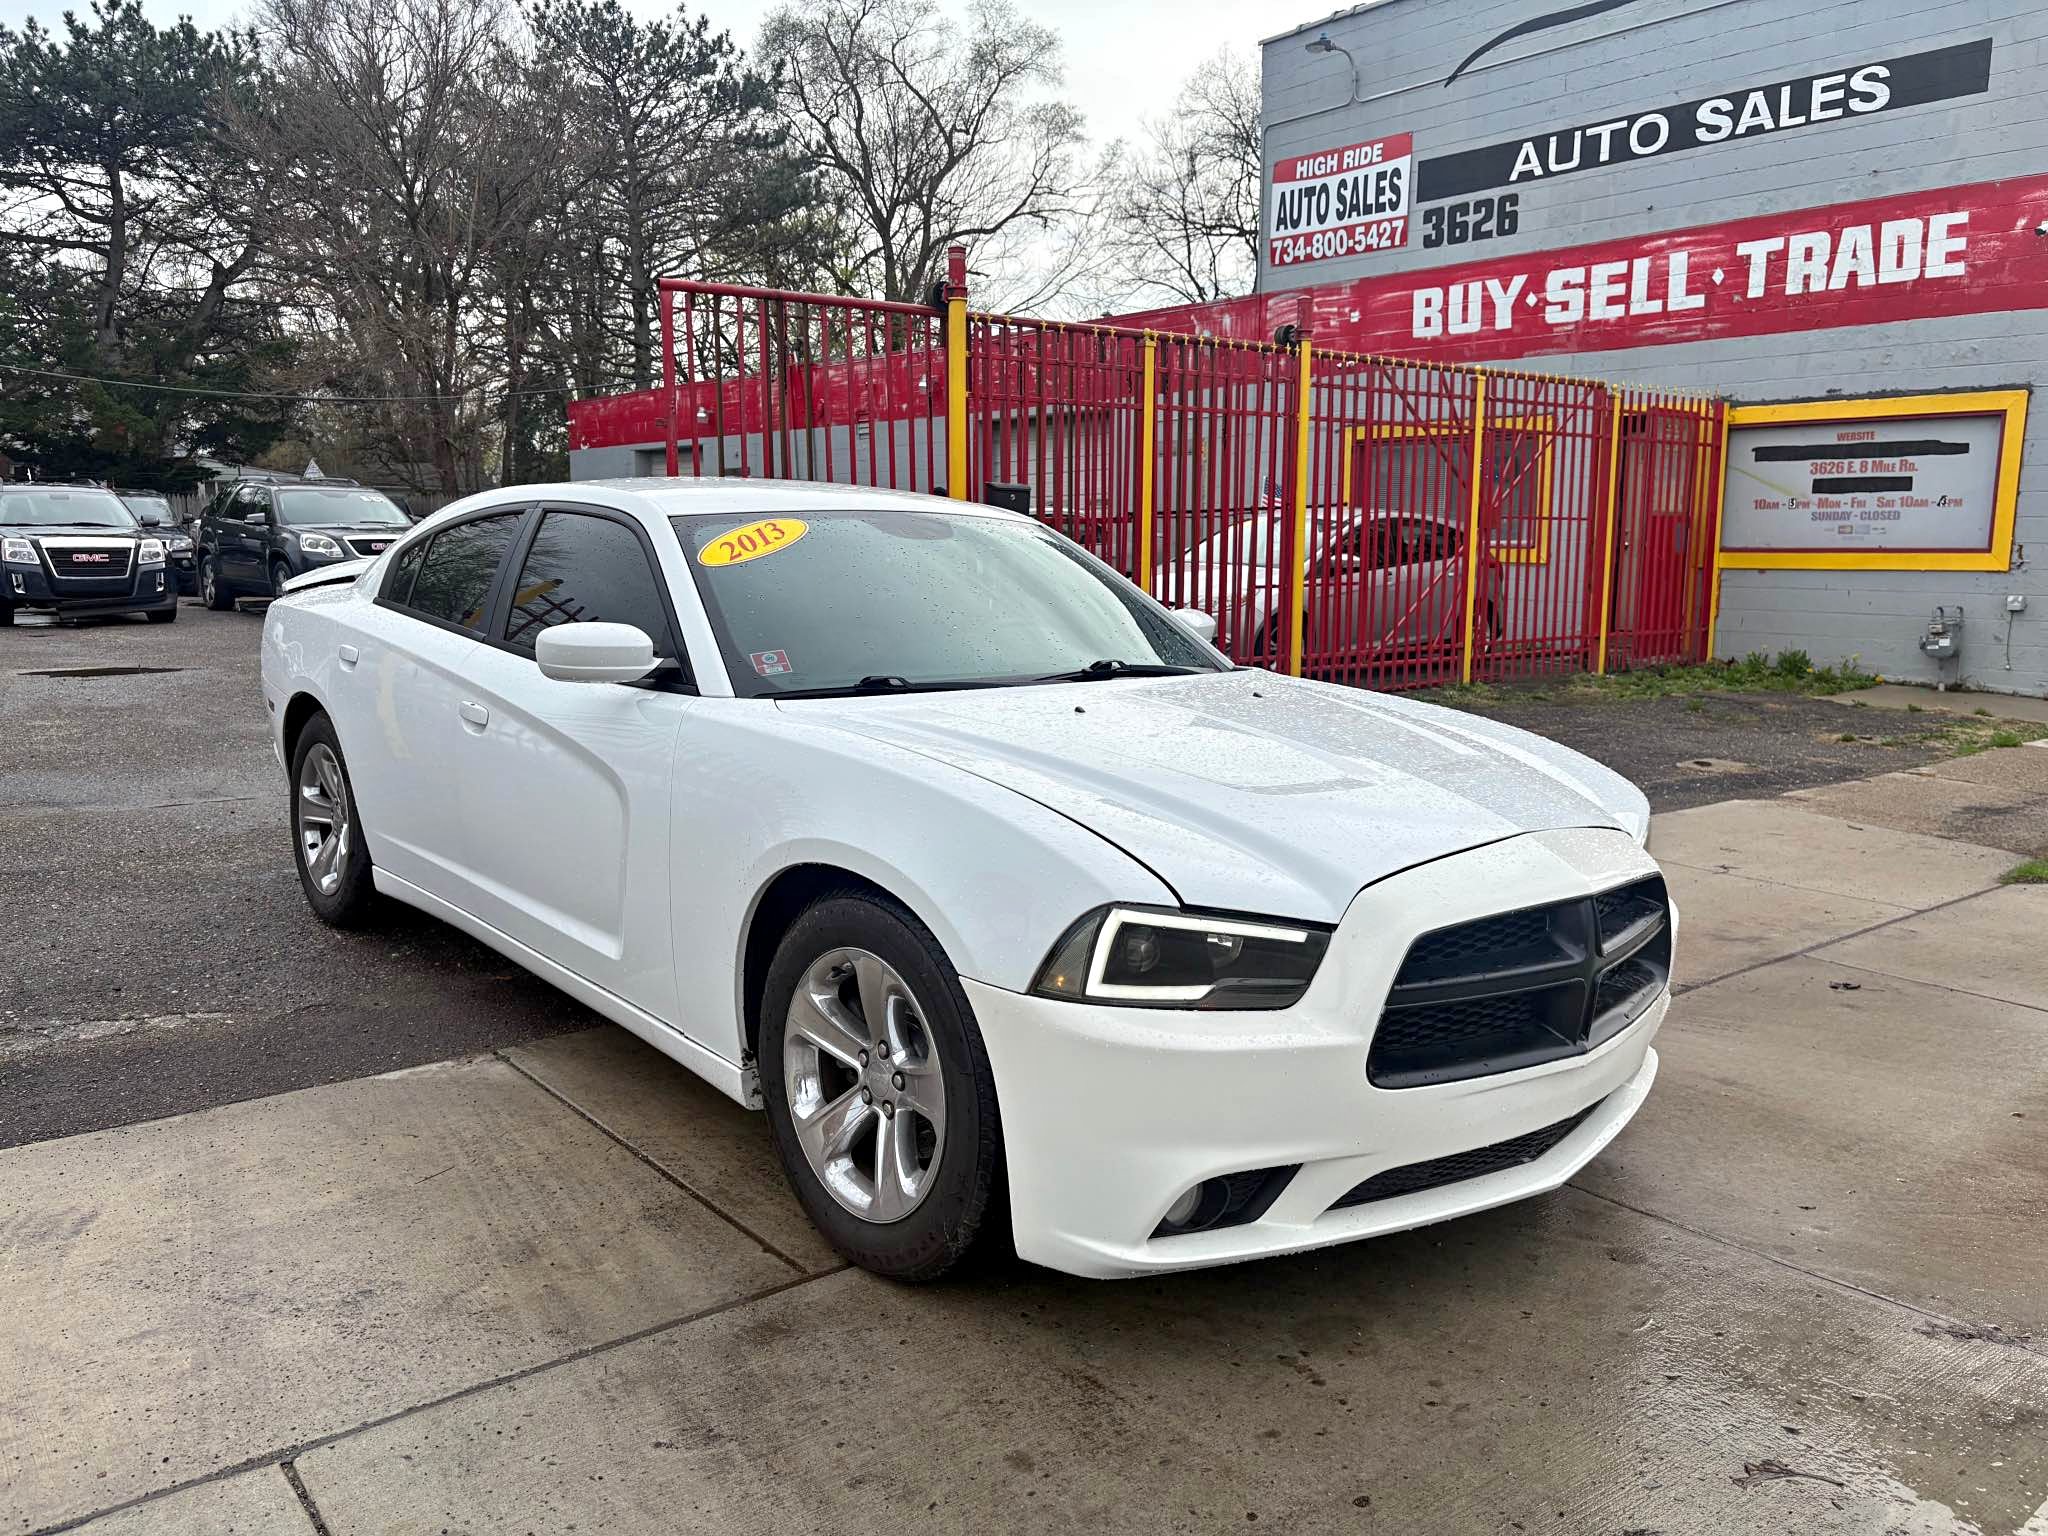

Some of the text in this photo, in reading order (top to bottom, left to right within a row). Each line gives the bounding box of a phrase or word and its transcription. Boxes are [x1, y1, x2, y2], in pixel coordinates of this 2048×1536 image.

[1509, 64, 1892, 182] AUTO SALES
[1296, 143, 1384, 180] HIGH RIDE
[1275, 167, 1402, 232] AUTO SALES
[1423, 193, 1519, 248] 3626
[1271, 219, 1405, 265] 734-800-5427
[1412, 210, 1970, 339] BUY SELL TRADE
[1837, 431, 1876, 442] WEBSITE
[1810, 461, 1845, 475] 3626
[1859, 460, 1868, 473] 8
[1811, 511, 1852, 521] SUNDAY
[1860, 510, 1901, 521] CLOSED
[72, 553, 110, 562] GMC
[719, 522, 785, 561] 2013
